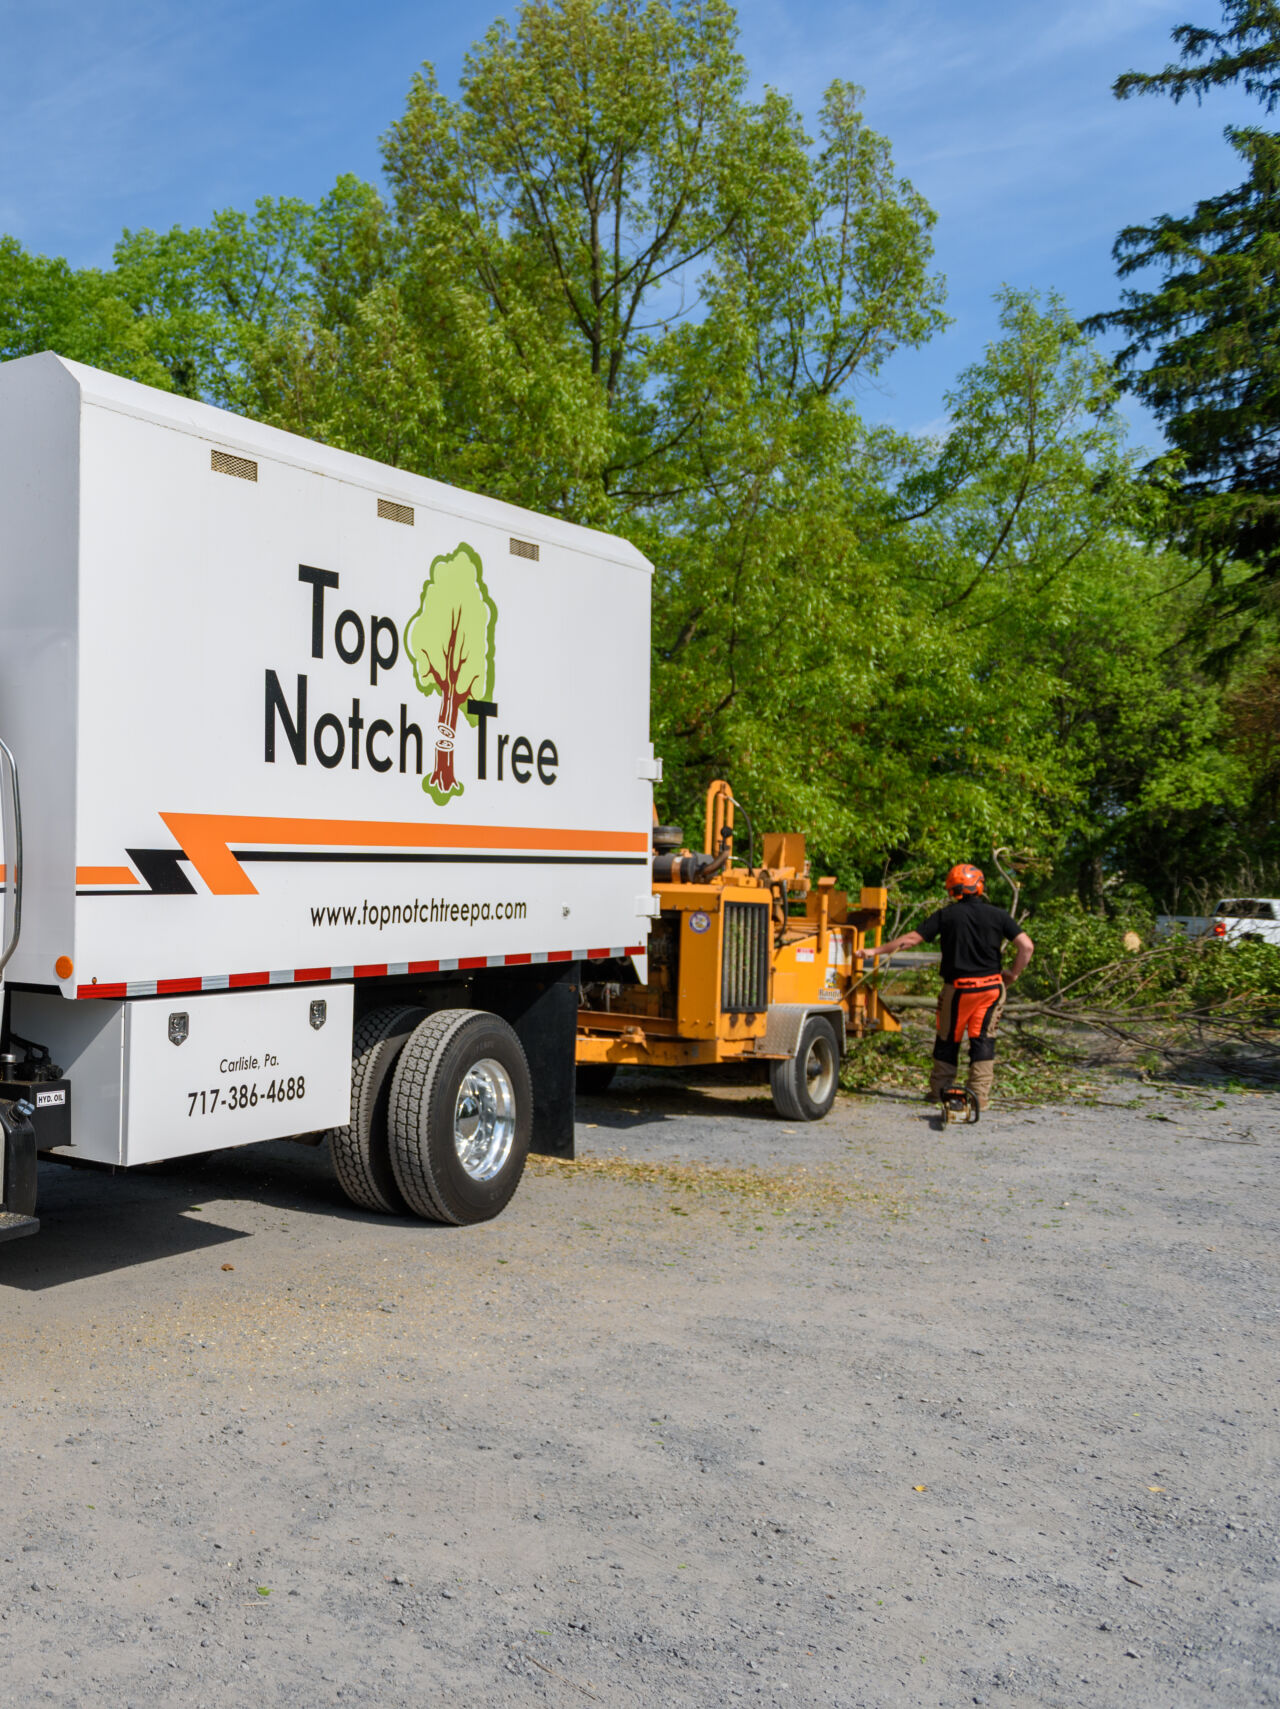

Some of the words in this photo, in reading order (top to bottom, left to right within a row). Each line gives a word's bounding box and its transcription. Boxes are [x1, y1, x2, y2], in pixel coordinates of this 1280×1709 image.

[298, 563, 399, 686] Top
[264, 668, 423, 775] Notch
[467, 698, 559, 786] Tree
[310, 897, 527, 931] www.topnotchtreepa.com
[219, 1055, 261, 1073] Carlisle,
[264, 1053, 280, 1068] Pa.
[38, 1095, 53, 1104] HYD.
[53, 1094, 64, 1102] OIL
[187, 1075, 306, 1117] 717-386-4688
